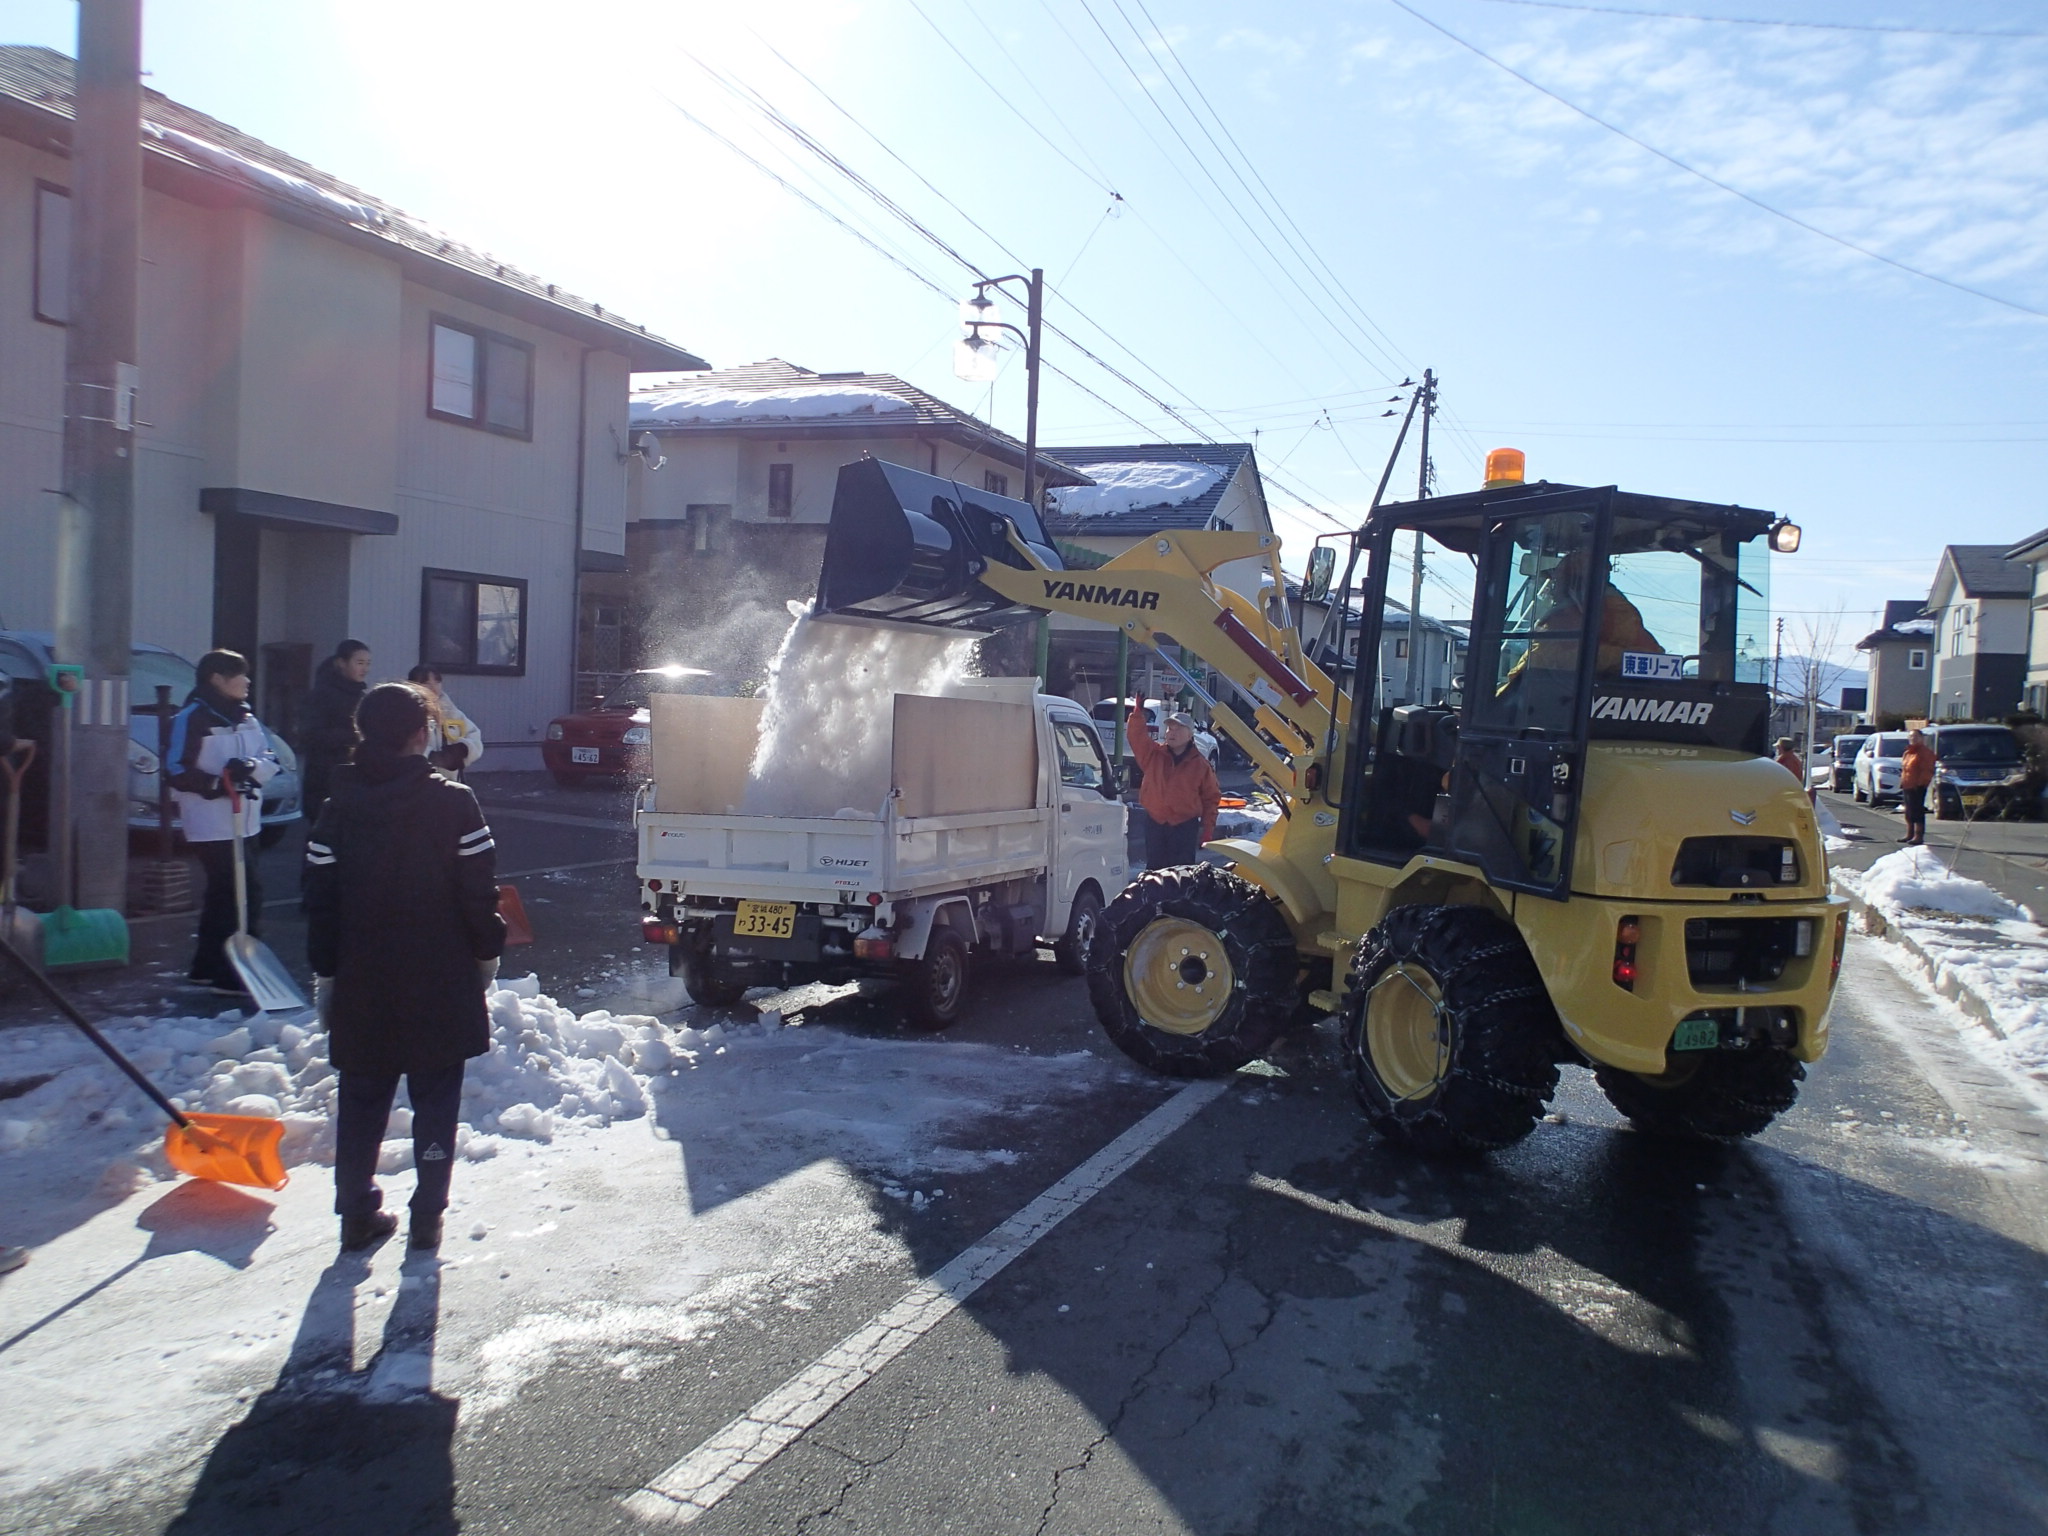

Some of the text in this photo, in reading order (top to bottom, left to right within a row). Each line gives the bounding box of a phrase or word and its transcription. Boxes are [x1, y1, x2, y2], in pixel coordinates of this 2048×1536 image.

[1043, 579, 1160, 610] YANMAR
[1624, 655, 1681, 677] 東亜リース
[1590, 695, 1714, 725] YANMAR
[835, 859, 869, 867] HIJET
[768, 905, 783, 915] 480
[747, 915, 791, 935] 33-45
